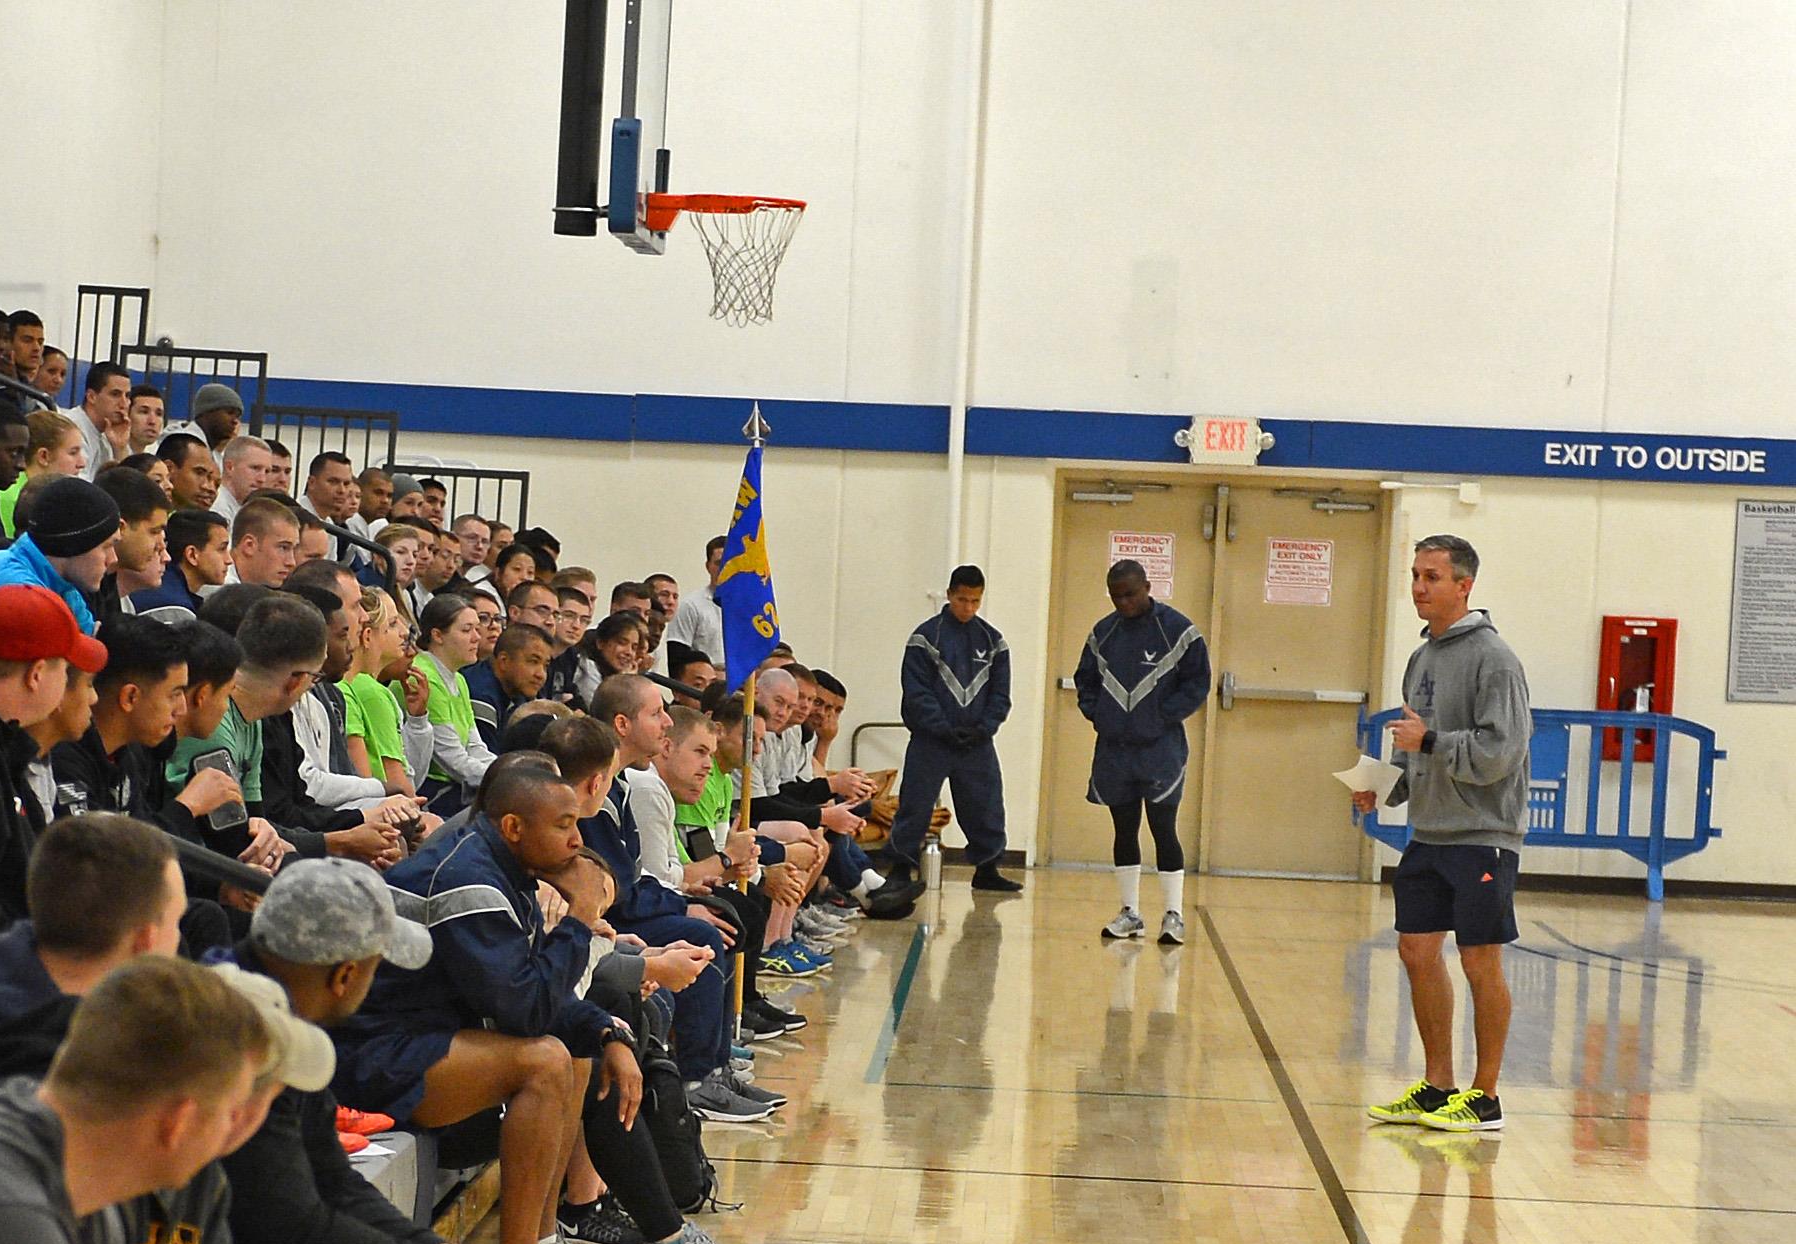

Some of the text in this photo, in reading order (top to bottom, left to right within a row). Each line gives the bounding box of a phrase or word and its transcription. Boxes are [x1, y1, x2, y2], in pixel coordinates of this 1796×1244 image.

[1205, 420, 1248, 451] EXIT
[1544, 442, 1767, 473] EXIT TO OUTSIDE
[1744, 504, 1796, 514] Basketball
[1114, 535, 1170, 545] EMERGENCY
[1119, 545, 1164, 554] EXIT ONLY
[1272, 543, 1329, 552] EMERGENCY
[1277, 551, 1323, 560] EXIT ONLY
